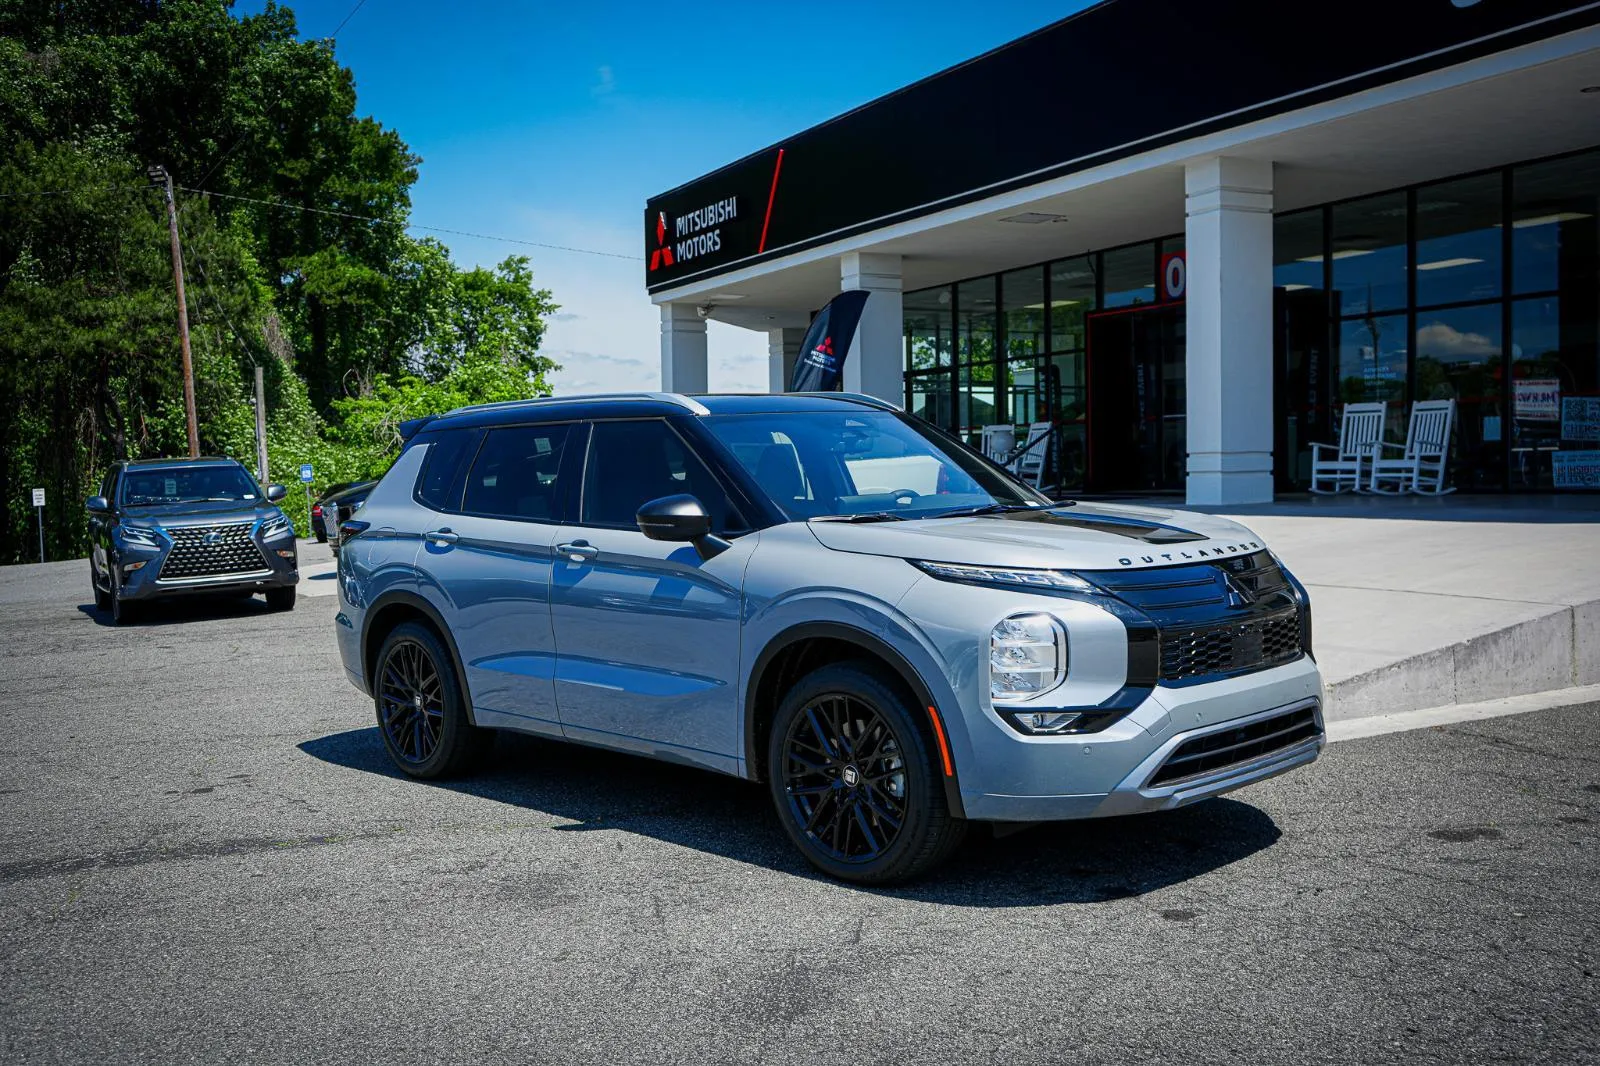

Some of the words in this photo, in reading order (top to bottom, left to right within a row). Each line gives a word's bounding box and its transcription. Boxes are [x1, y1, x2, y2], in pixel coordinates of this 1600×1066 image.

[676, 196, 737, 238] MITSUBISHI
[677, 229, 721, 263] MOTORS
[1118, 542, 1260, 567] OUTLANDER
